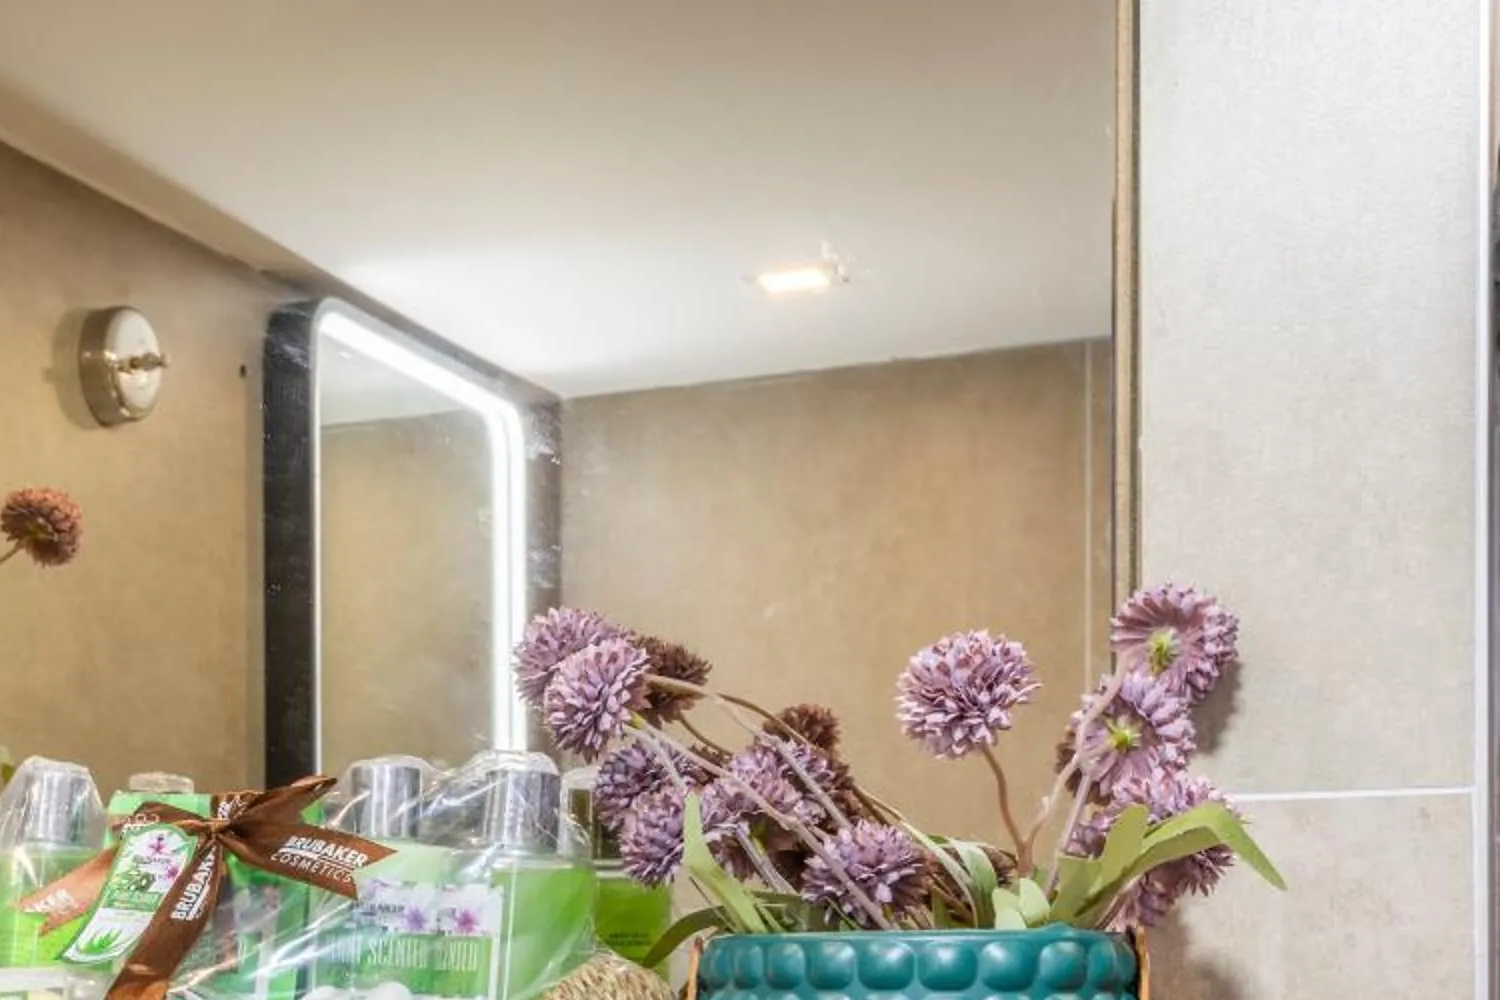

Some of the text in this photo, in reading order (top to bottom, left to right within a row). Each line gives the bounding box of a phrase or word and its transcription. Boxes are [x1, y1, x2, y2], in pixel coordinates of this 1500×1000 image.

[270, 851, 352, 883] COSMETICS
[283, 835, 369, 867] BRUBAKER
[170, 847, 217, 921] BRUBAK
